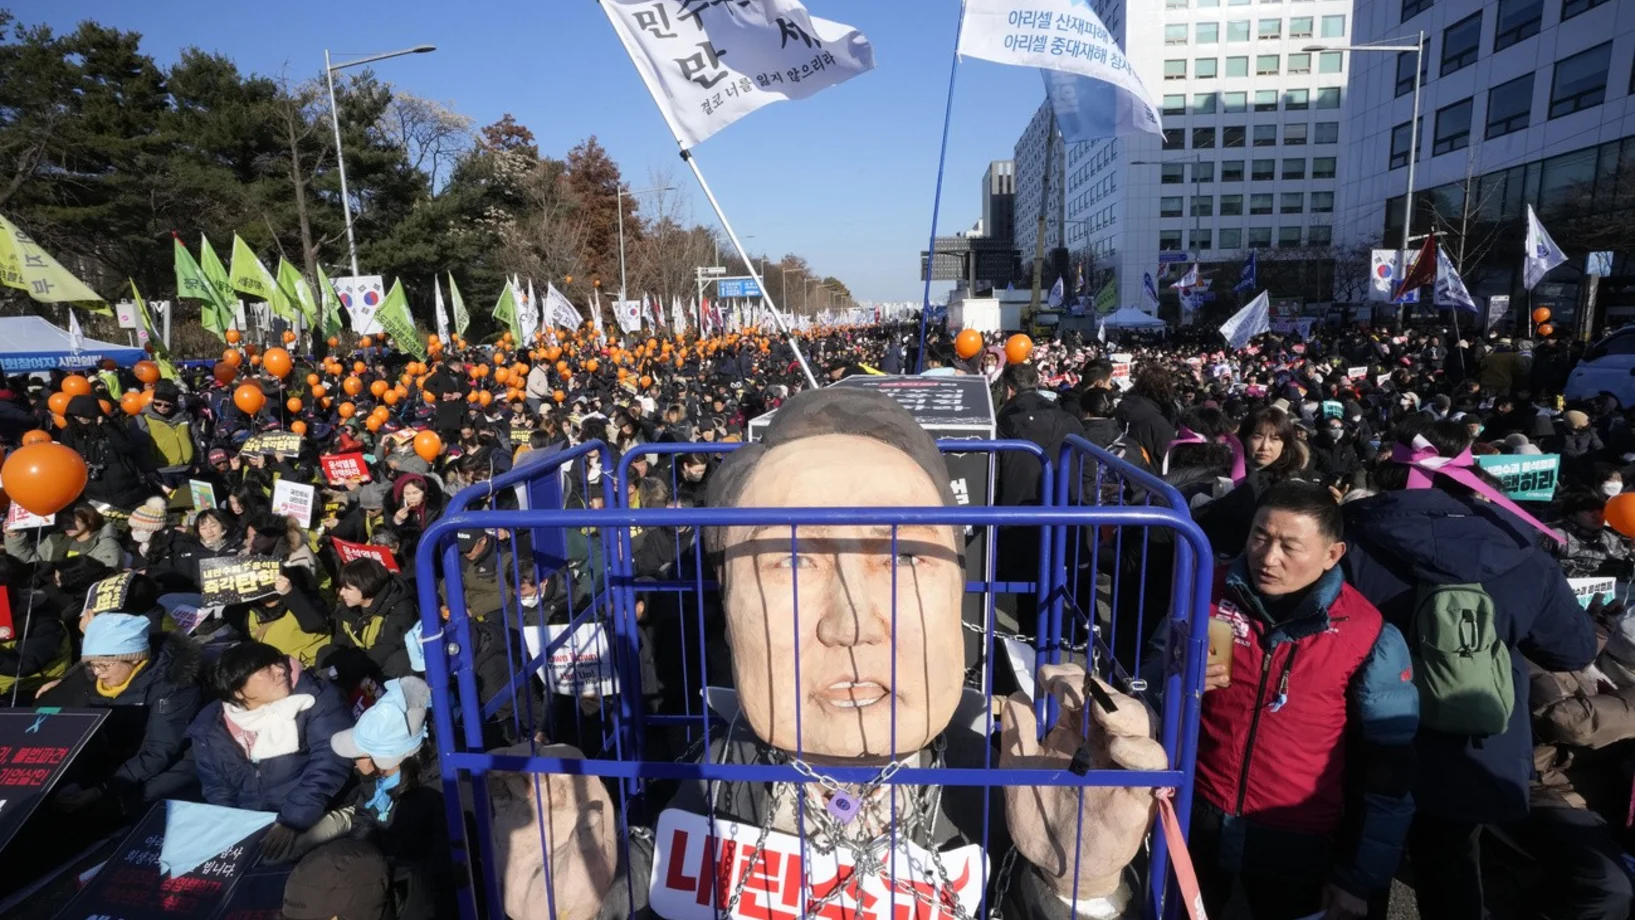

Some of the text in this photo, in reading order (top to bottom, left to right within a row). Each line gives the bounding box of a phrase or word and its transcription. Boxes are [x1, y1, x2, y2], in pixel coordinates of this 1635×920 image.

[1008, 10, 1110, 44] 아리셀 산재피해
[1004, 34, 1048, 53] 아리셀
[1050, 36, 1107, 65] 중대재해
[700, 51, 836, 116] 결코 너를 잃지 않으리라
[0, 357, 56, 370] 회참여자
[11, 747, 69, 764] 불법파견
[124, 849, 163, 866] 희생자
